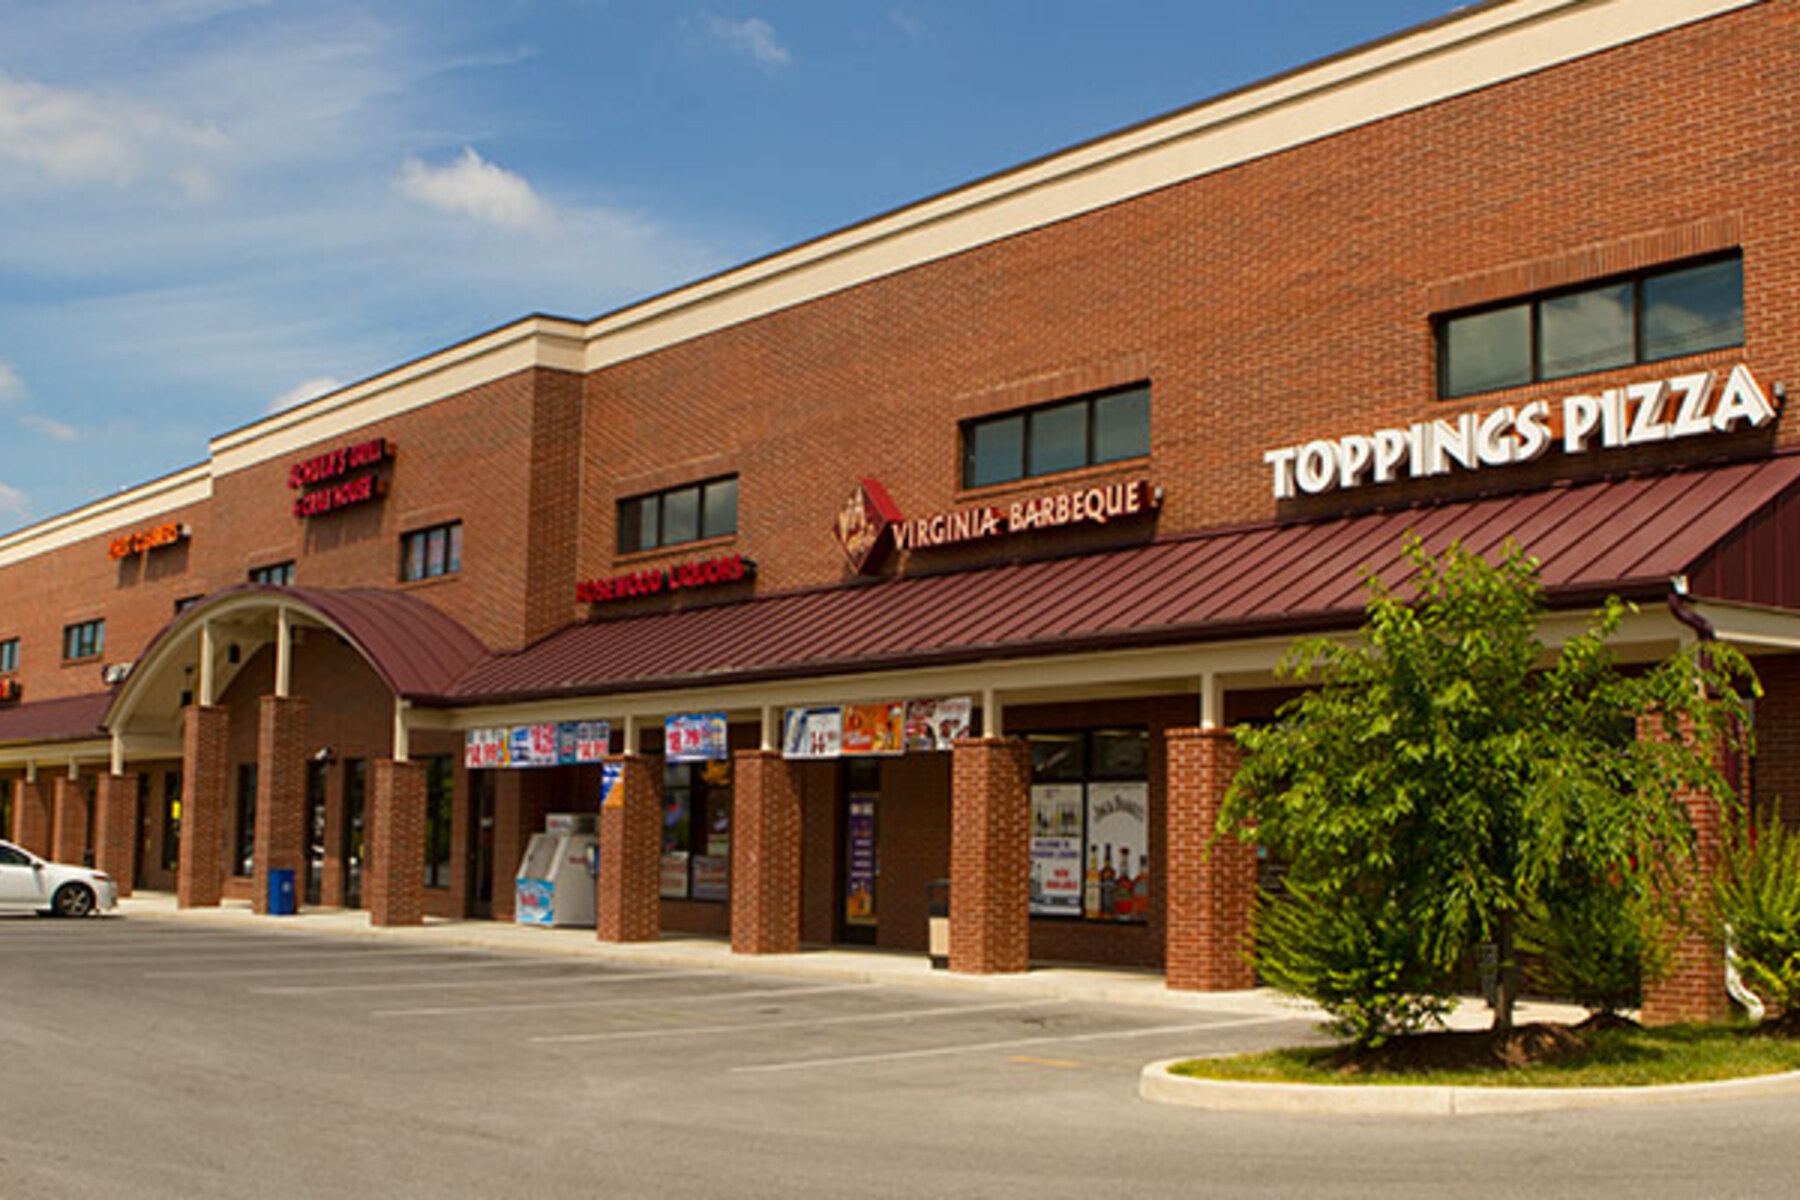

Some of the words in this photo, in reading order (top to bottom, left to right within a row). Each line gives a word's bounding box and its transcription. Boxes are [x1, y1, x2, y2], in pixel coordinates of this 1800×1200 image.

[1263, 399, 1552, 499] TOPPINGS
[1563, 363, 1776, 454] PIZZA
[892, 508, 999, 550] VIRGINIA
[1008, 480, 1141, 533] BARBEQUE
